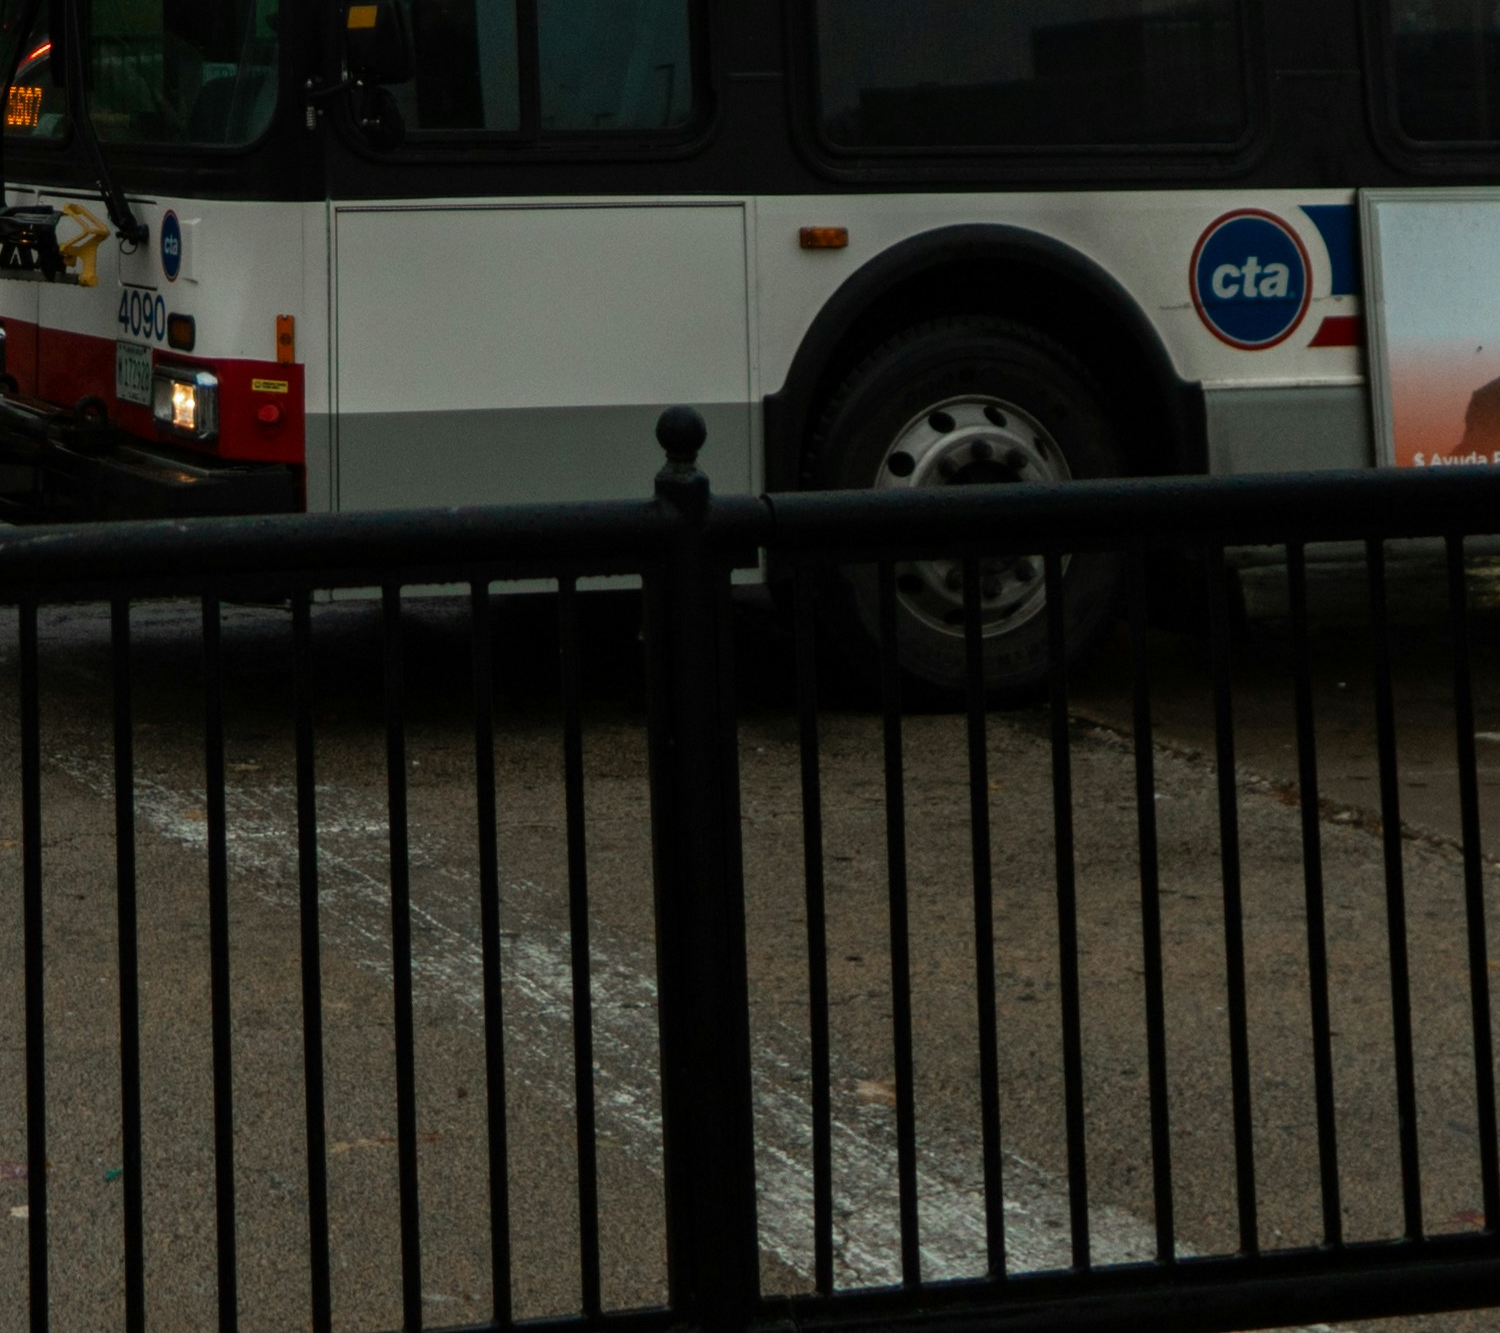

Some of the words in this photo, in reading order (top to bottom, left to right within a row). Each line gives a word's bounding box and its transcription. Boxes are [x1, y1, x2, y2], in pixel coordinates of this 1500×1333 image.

[164, 233, 178, 256] cta
[1211, 255, 1291, 300] cta
[118, 289, 166, 342] 4090
